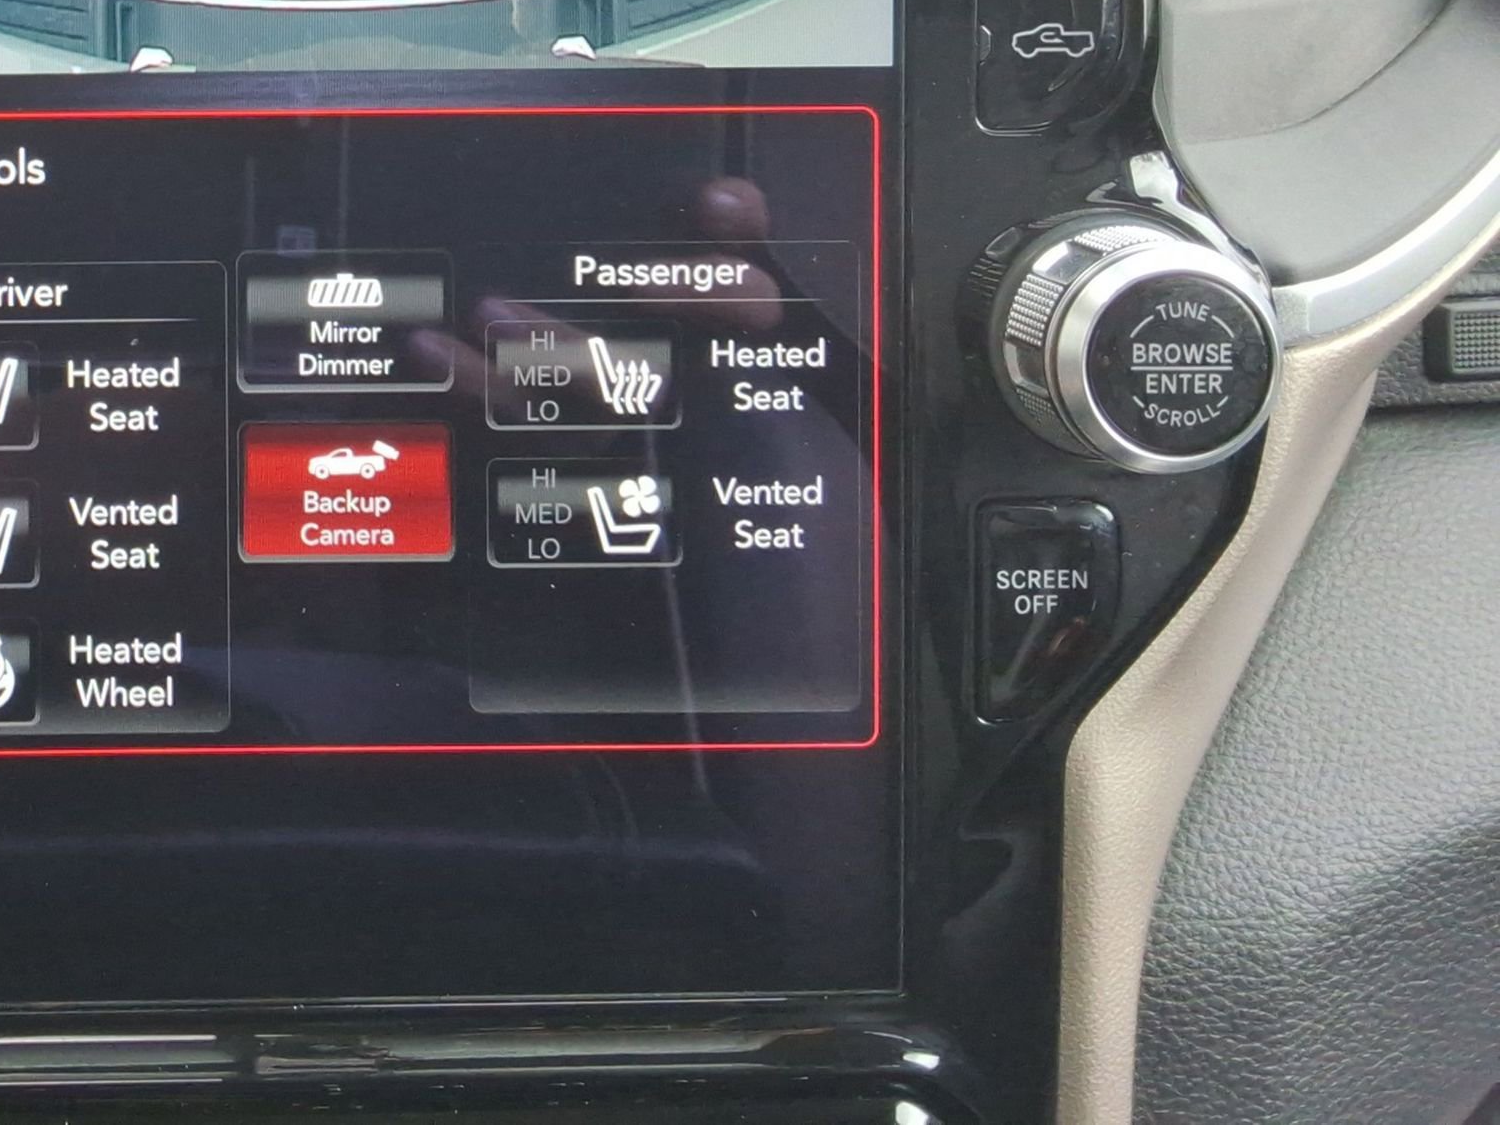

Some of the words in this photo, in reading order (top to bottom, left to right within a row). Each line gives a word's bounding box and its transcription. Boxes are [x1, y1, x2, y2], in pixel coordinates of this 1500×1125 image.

[574, 256, 750, 290] Passenger
[1155, 301, 1211, 324] TUNE
[309, 321, 382, 344] Mirror
[530, 330, 556, 352] HI
[710, 337, 827, 367] Heated
[1131, 342, 1233, 364] BROWSE
[66, 357, 180, 388] Heated
[299, 354, 394, 376] Dimmer
[514, 365, 571, 387] MED
[1145, 373, 1223, 395] ENTER
[733, 382, 804, 412] Seat
[89, 403, 159, 431] Seat
[526, 400, 560, 422] LO
[1143, 403, 1221, 428] SCROLL
[531, 469, 557, 489] HI
[712, 475, 824, 506] Vented
[69, 495, 179, 527] Vented
[303, 491, 391, 519] Backup
[515, 503, 573, 525] MED
[300, 524, 395, 546] Camera
[733, 520, 804, 549] Seat
[90, 540, 160, 570] Seat
[527, 538, 561, 560] LO
[995, 570, 1088, 590] SCREEN
[1014, 594, 1059, 615] OFF
[69, 632, 183, 664] Heated
[77, 676, 174, 707] Wheel
